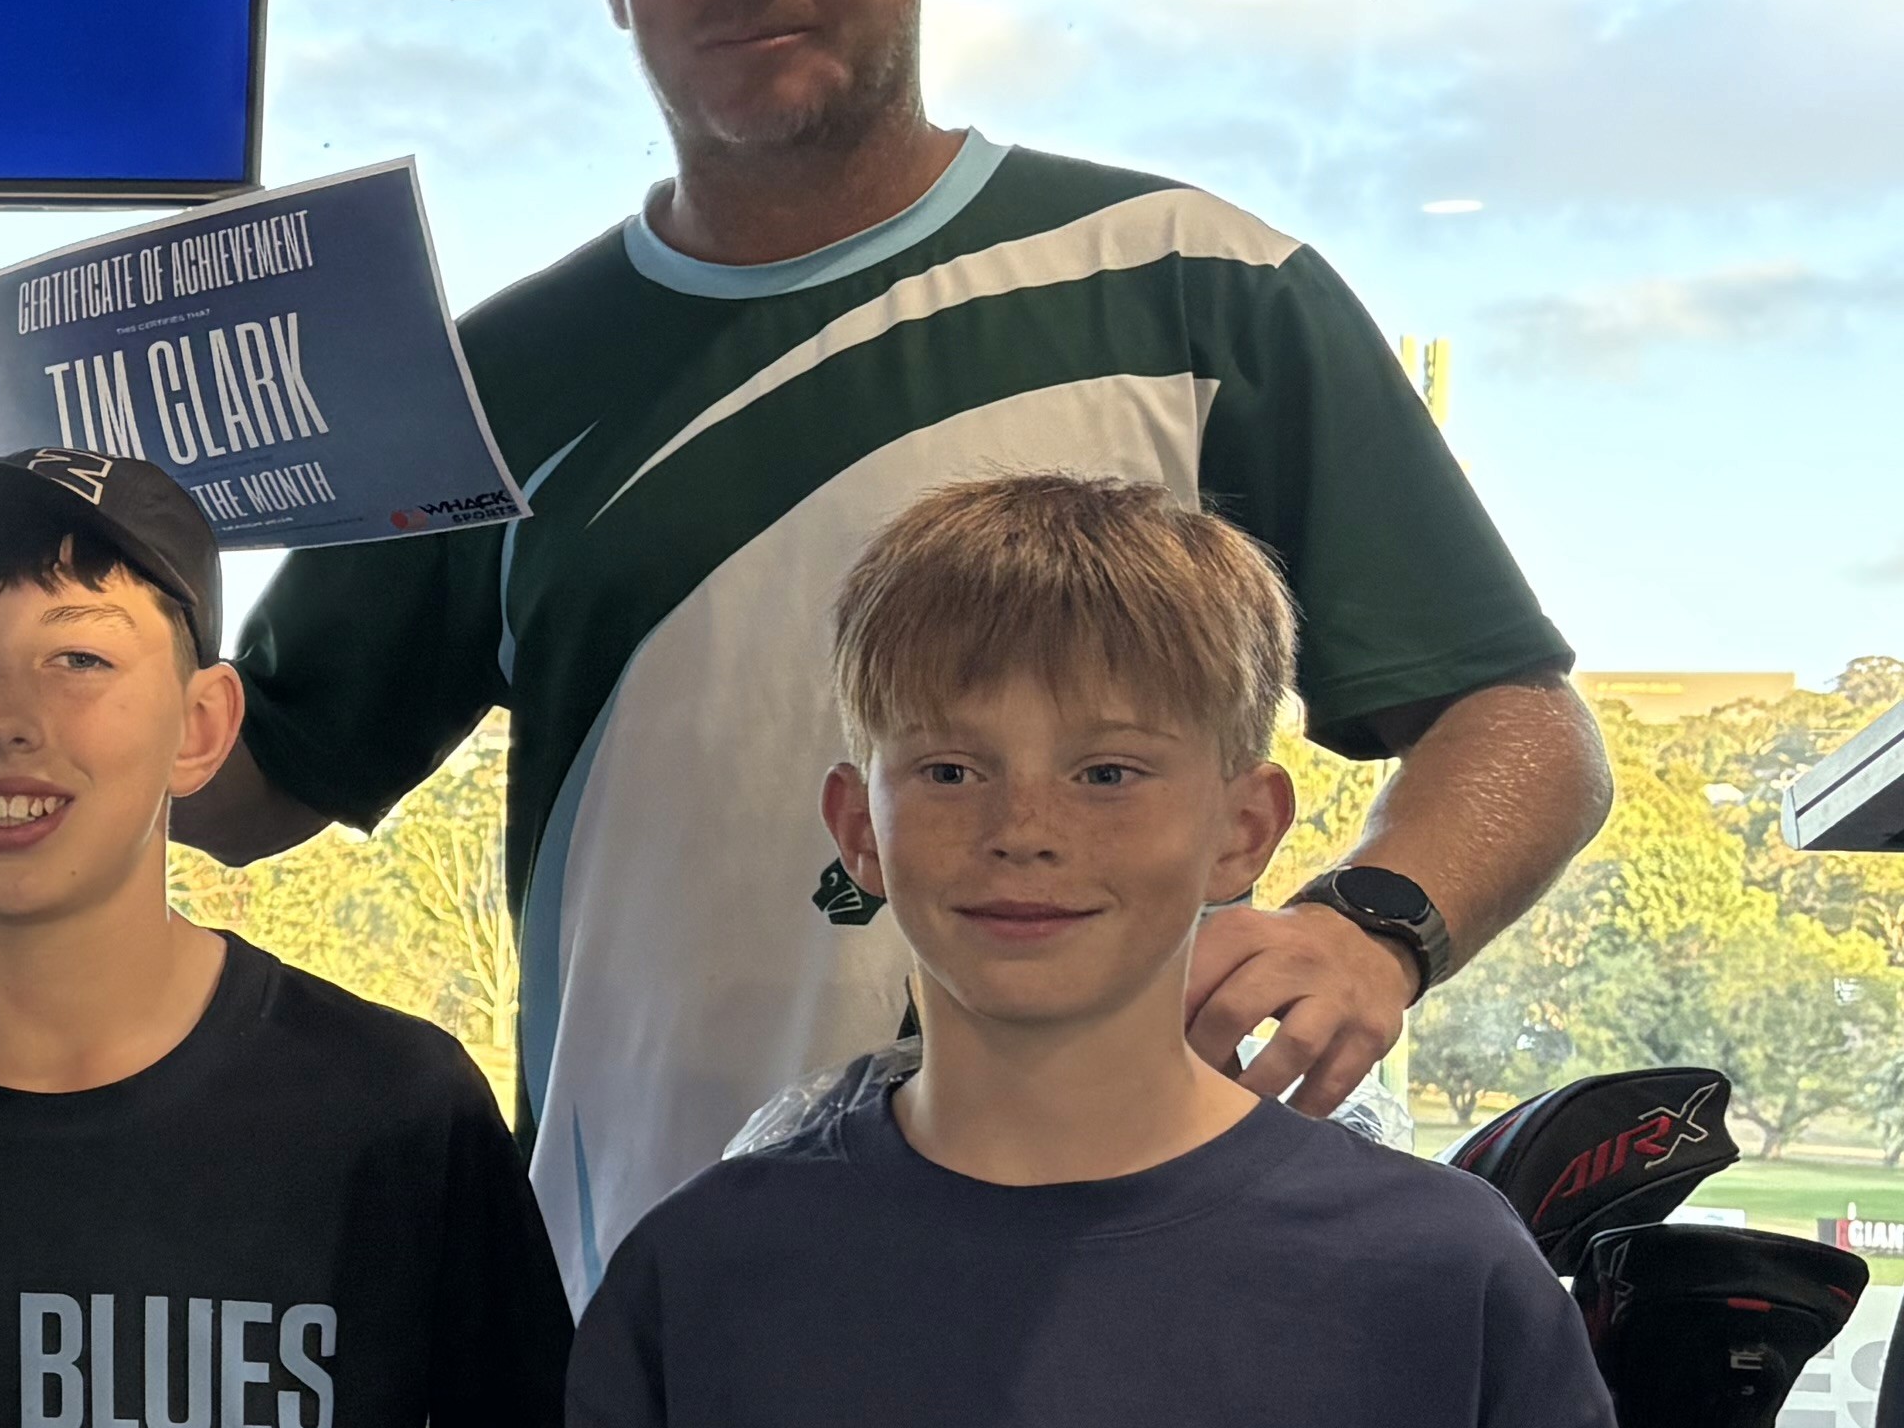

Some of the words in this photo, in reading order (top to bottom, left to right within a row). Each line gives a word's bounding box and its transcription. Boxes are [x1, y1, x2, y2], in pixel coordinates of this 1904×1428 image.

[18, 254, 136, 335] CERTIFICATE
[139, 245, 164, 305] OF
[170, 209, 314, 298] ACHIEVEMENT
[44, 350, 146, 461] TIM
[147, 312, 330, 466] CLARK
